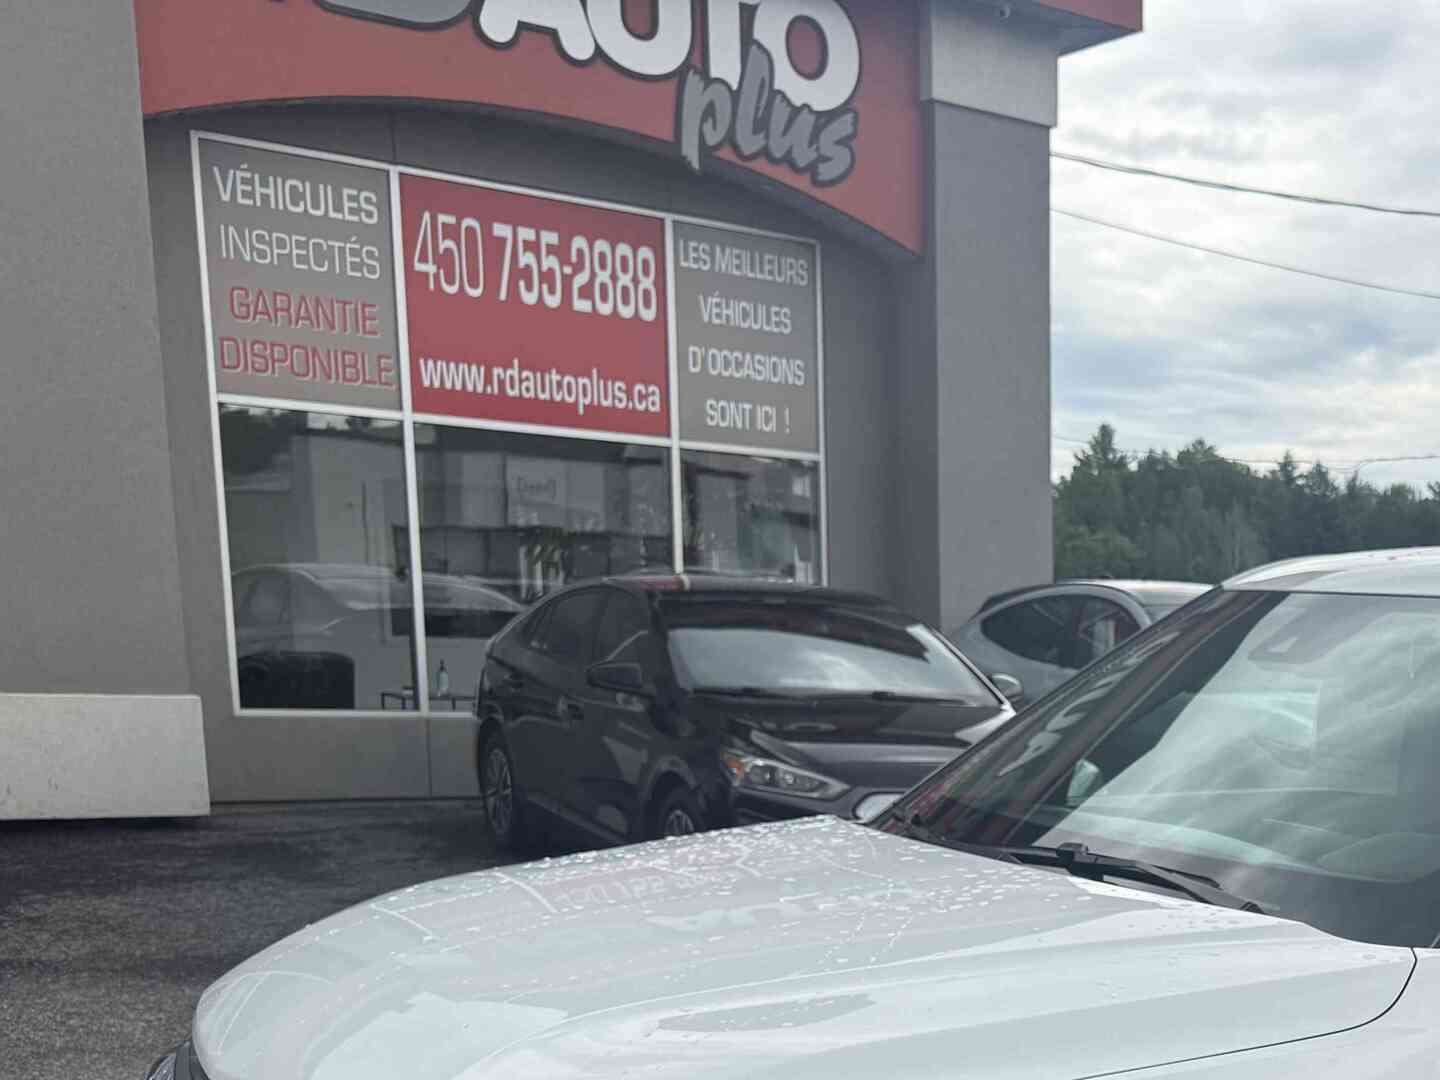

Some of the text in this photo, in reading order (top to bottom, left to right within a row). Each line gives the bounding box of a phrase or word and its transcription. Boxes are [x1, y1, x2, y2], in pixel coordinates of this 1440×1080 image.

[680, 43, 859, 182] plus
[213, 163, 379, 225] VÉHICULES
[219, 223, 381, 280] INSPECTÉS
[413, 210, 658, 322] 450 755-2888
[680, 239, 809, 287] LES MEILLEURS
[228, 285, 381, 339] GARANTIE
[698, 290, 792, 335] VÉHICULES
[218, 334, 398, 391] DISPONIBLE
[418, 357, 662, 416] www.rdautoplus.ca
[705, 398, 753, 431] SONT
[756, 404, 777, 433] ICI
